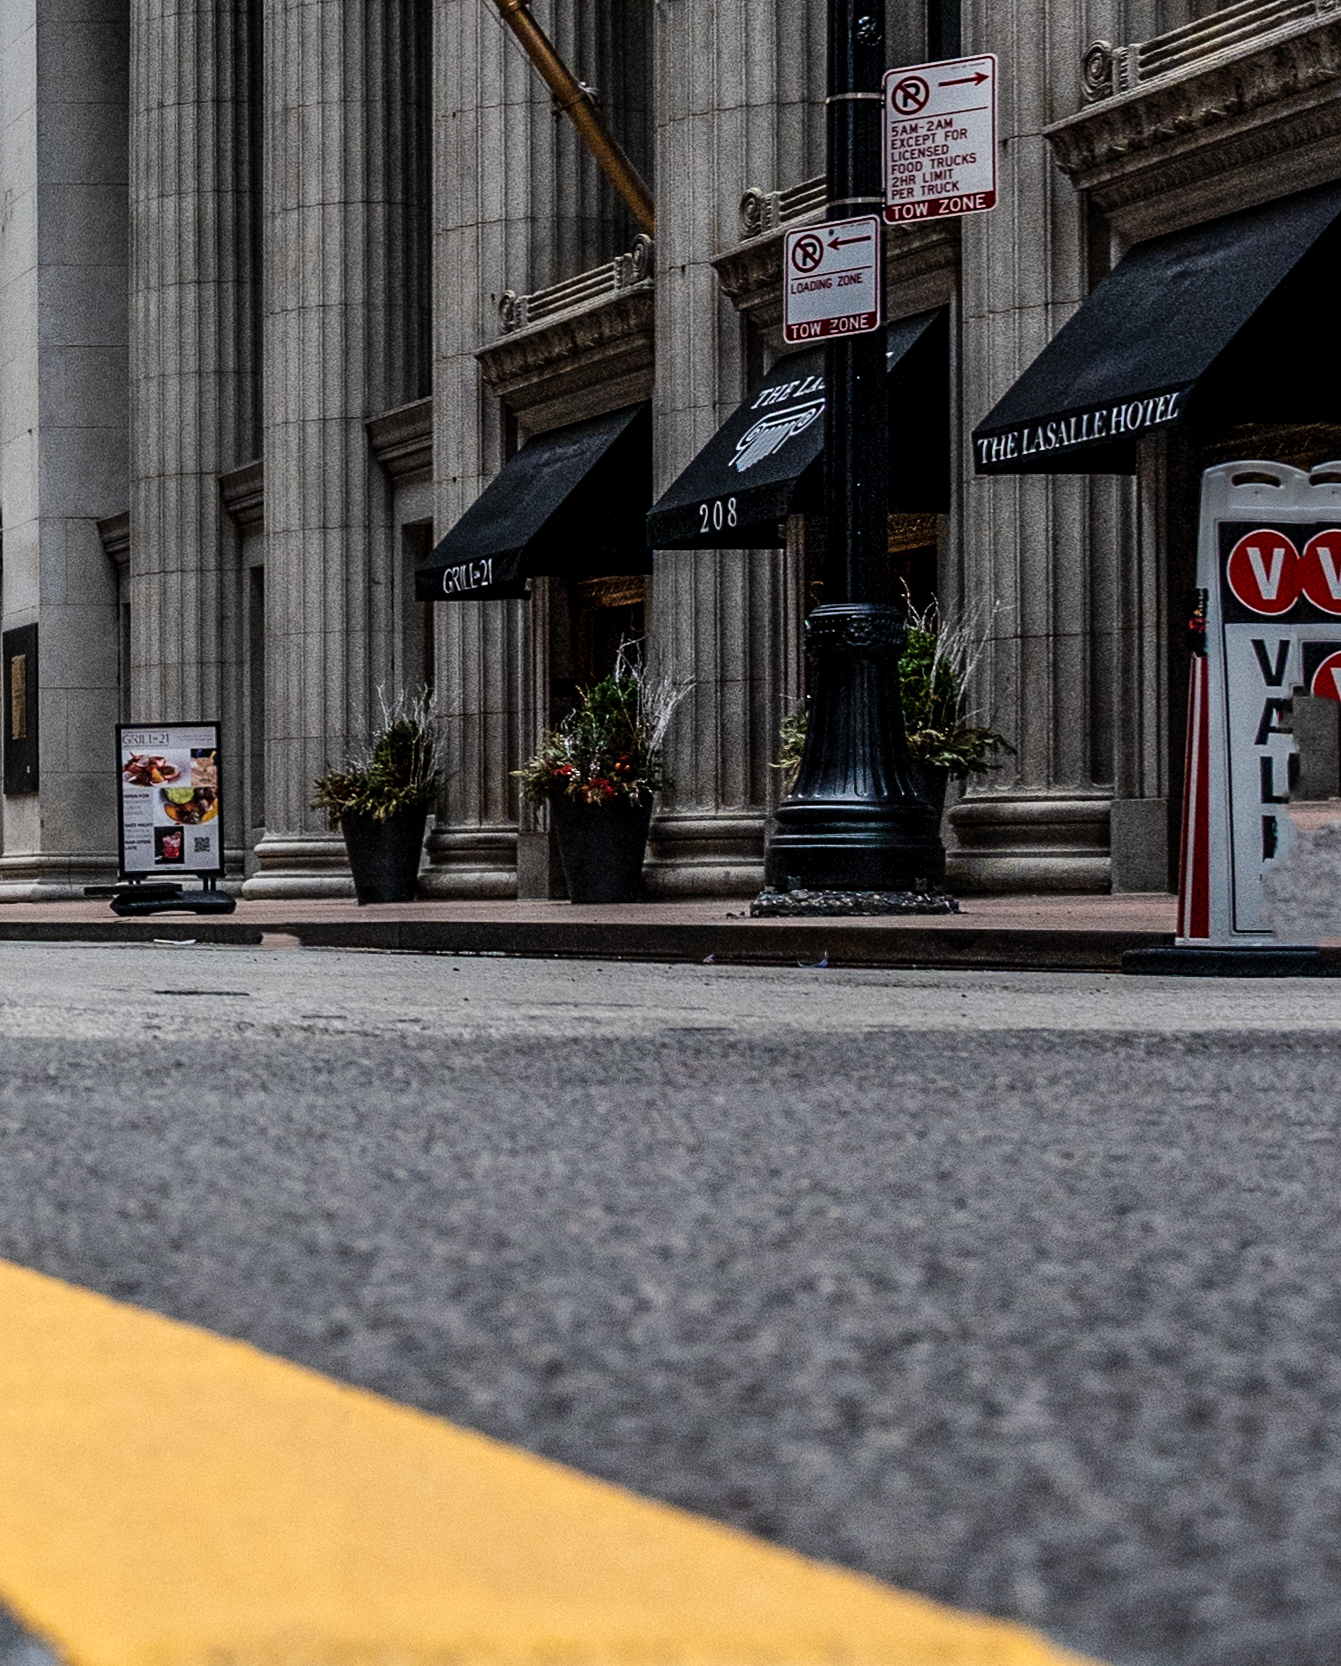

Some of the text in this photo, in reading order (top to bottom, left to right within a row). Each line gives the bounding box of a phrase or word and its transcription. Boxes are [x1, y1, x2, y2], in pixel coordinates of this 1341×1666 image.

[890, 128, 968, 151] EXCEPT FOR
[890, 144, 950, 163] LICENSED
[890, 152, 977, 176] FOOD TRUCKS
[890, 168, 954, 188] 2HR LIMIT
[890, 180, 960, 201] PER TRUCK
[891, 193, 987, 220] TOW ZONE
[790, 272, 863, 295] LOADING ZONE
[790, 314, 869, 339] TOW ZONE
[750, 380, 801, 410] THE
[977, 392, 1180, 464] THE LASALLE HOTEL
[699, 497, 737, 533] 208
[442, 562, 478, 594] GRILL
